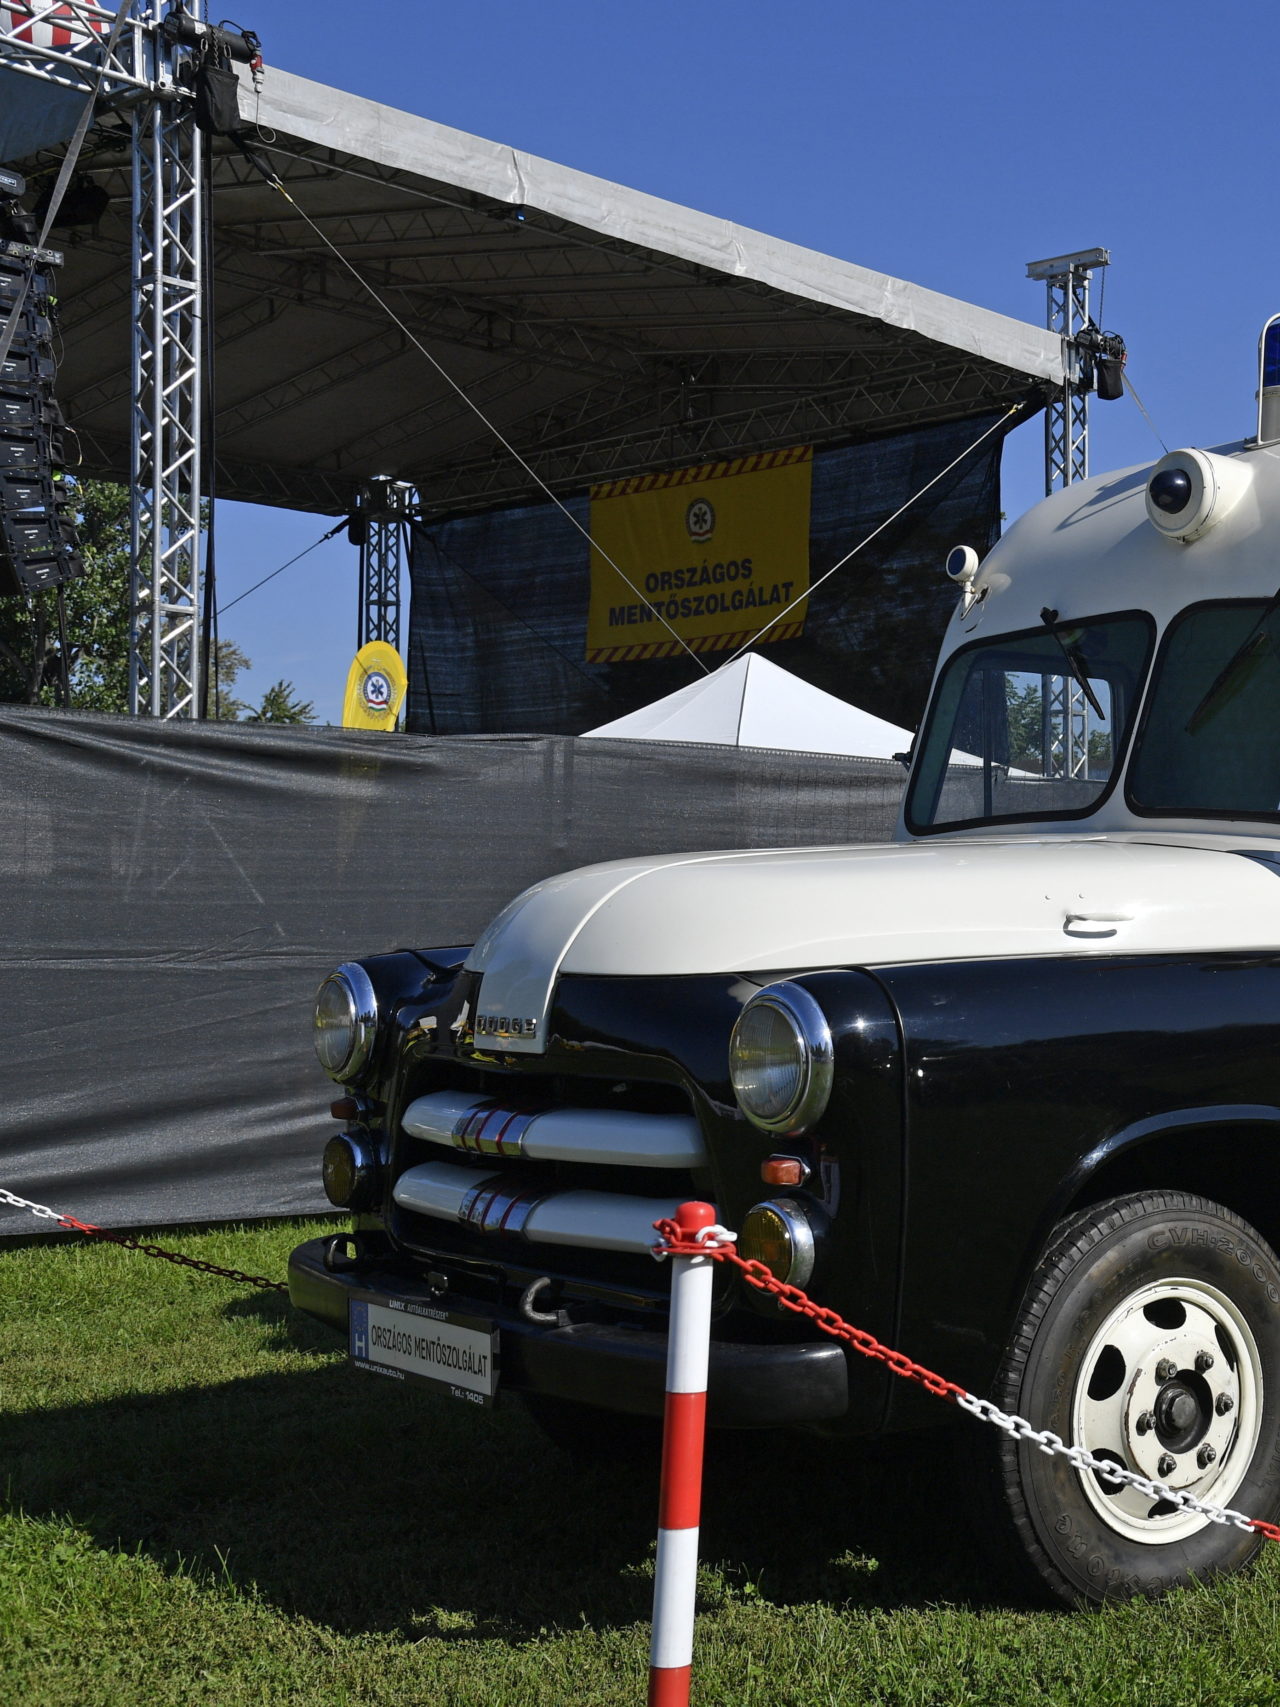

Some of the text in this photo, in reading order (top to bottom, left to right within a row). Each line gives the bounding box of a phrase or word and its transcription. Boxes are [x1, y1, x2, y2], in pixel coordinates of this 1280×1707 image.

[645, 559, 753, 593] ORSZÁGOS
[608, 582, 794, 627] MENTŐSZOLGÁLAT
[476, 1014, 537, 1037] DODGE
[355, 1333, 366, 1358] H
[371, 1324, 488, 1378] ORSZÁGOS MENTŐSZOLGÁLAT
[354, 1361, 405, 1380] www.unixauto.hu
[466, 1391, 484, 1405] 1405
